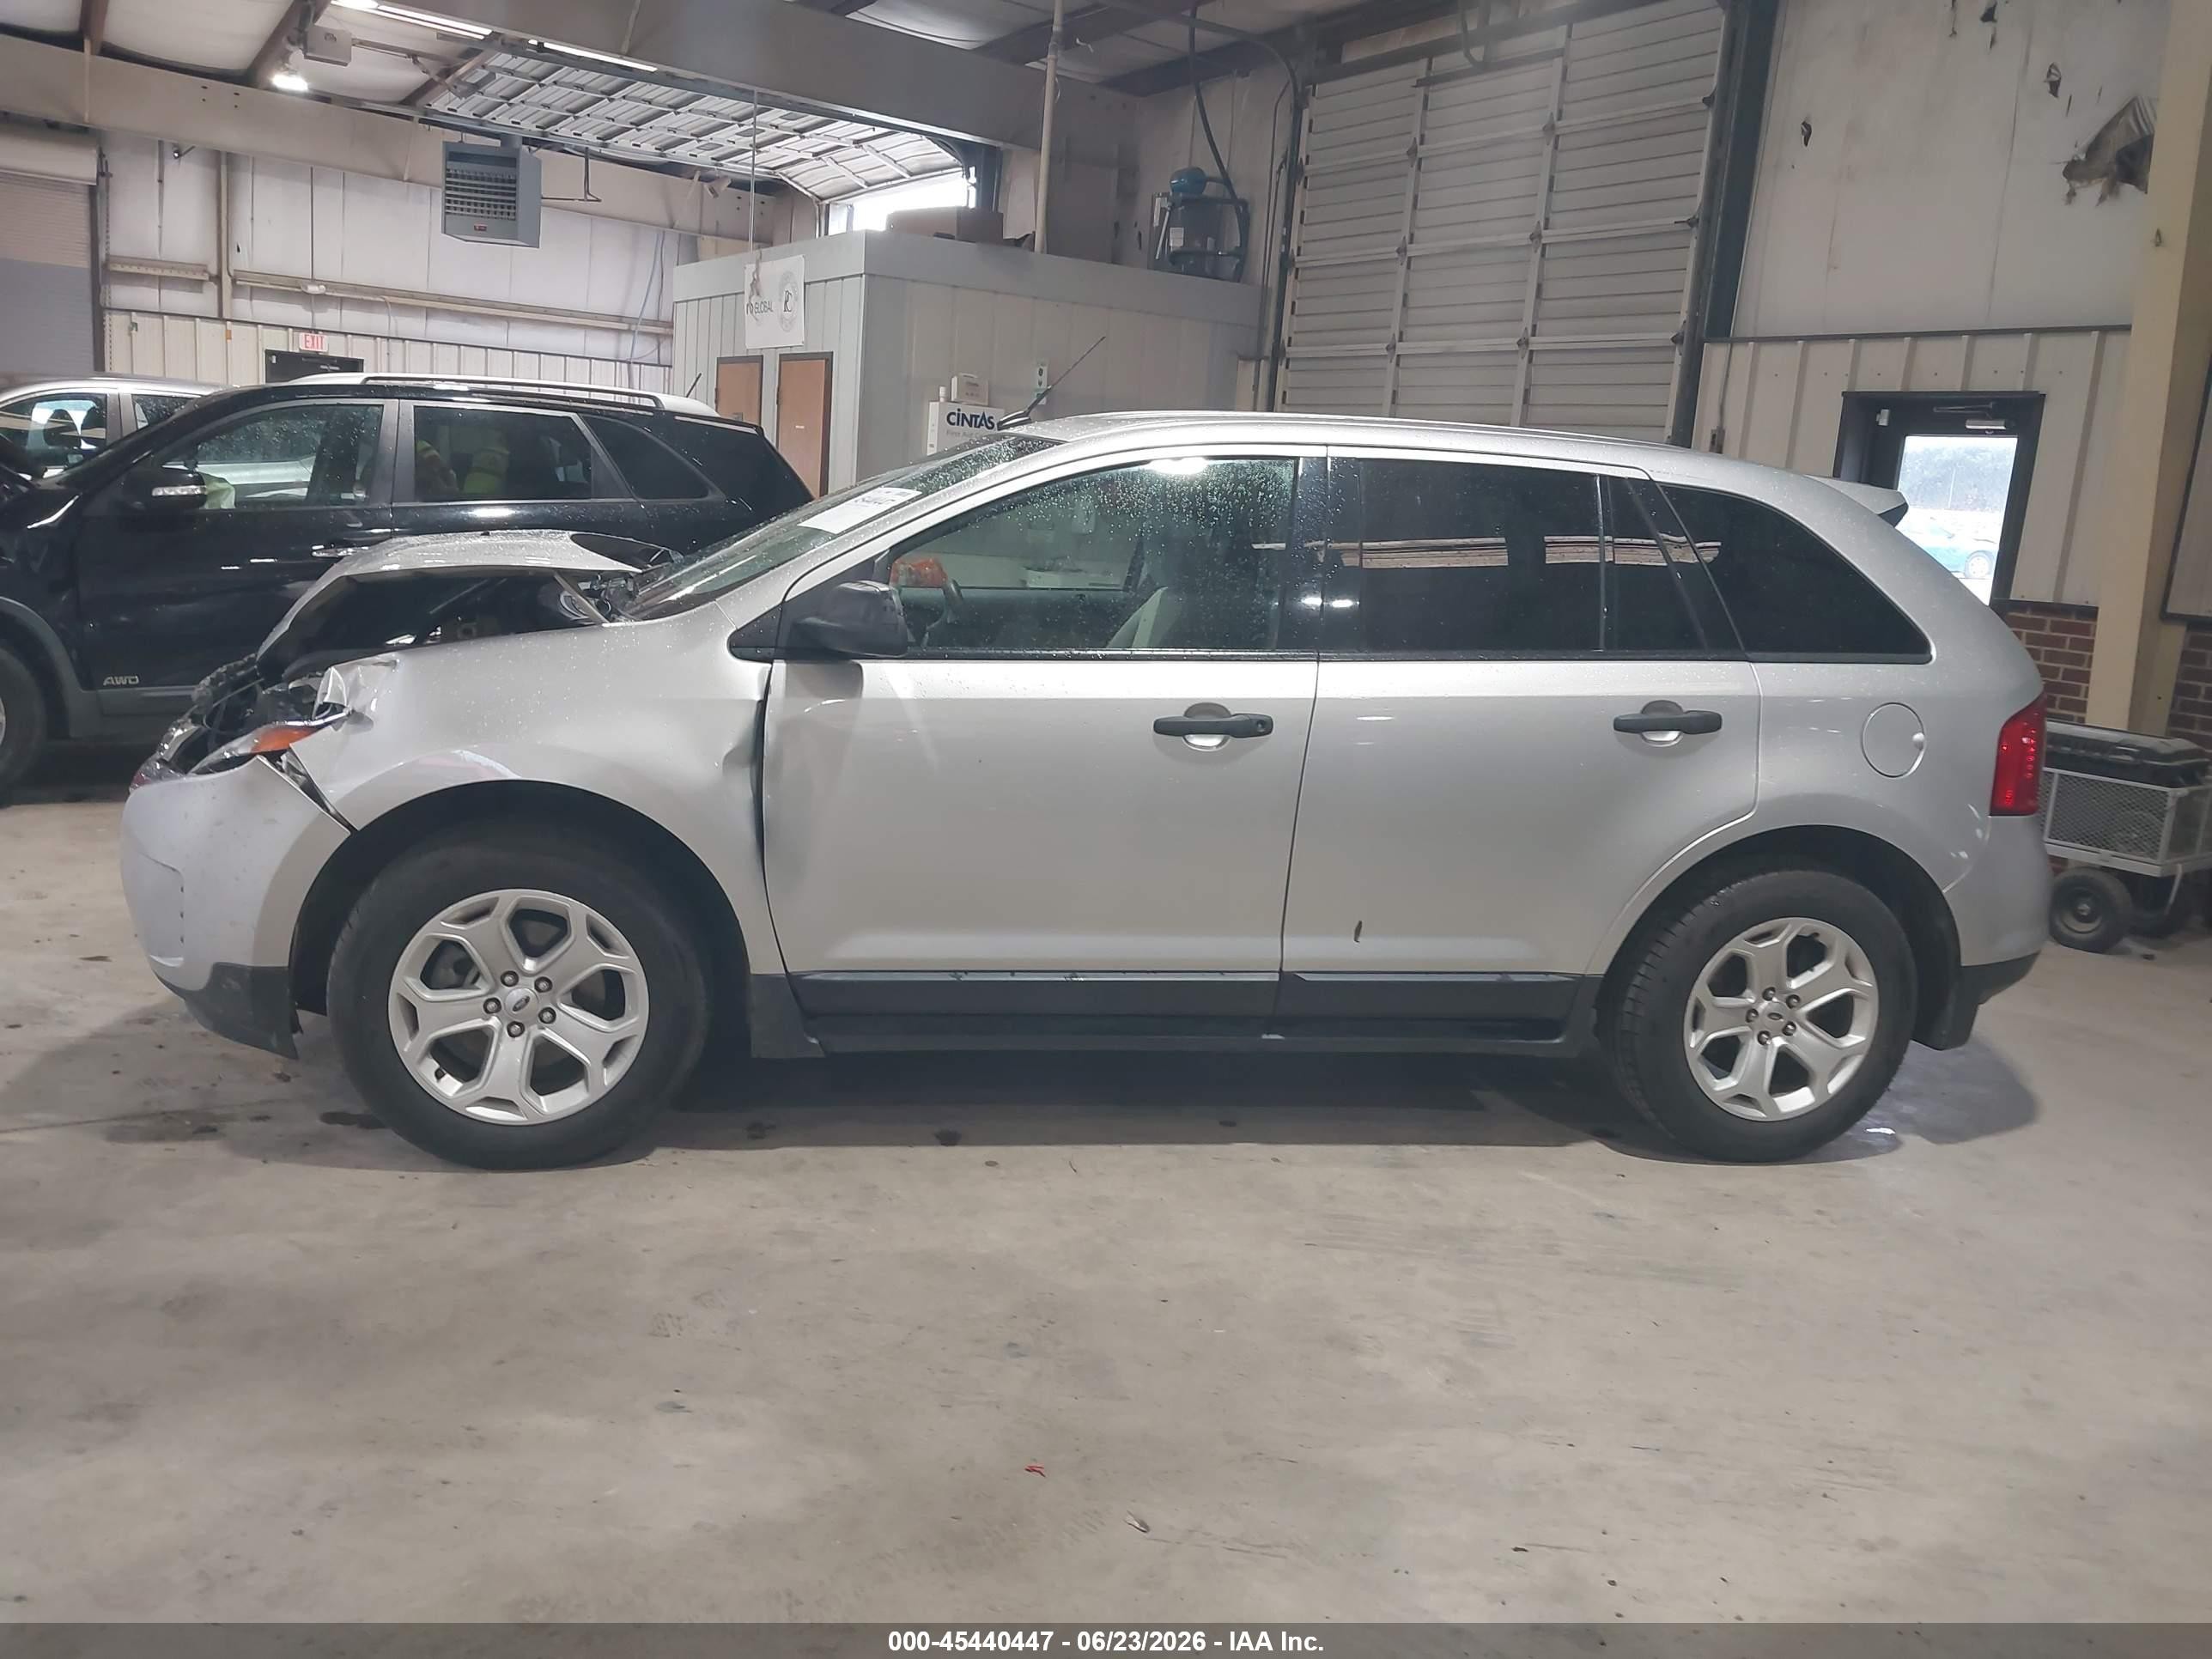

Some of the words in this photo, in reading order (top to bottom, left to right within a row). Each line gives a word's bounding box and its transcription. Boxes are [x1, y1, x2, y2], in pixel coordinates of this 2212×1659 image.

[304, 334, 324, 349] EXIT
[946, 408, 995, 430] CINTAS
[103, 675, 140, 686] AWD
